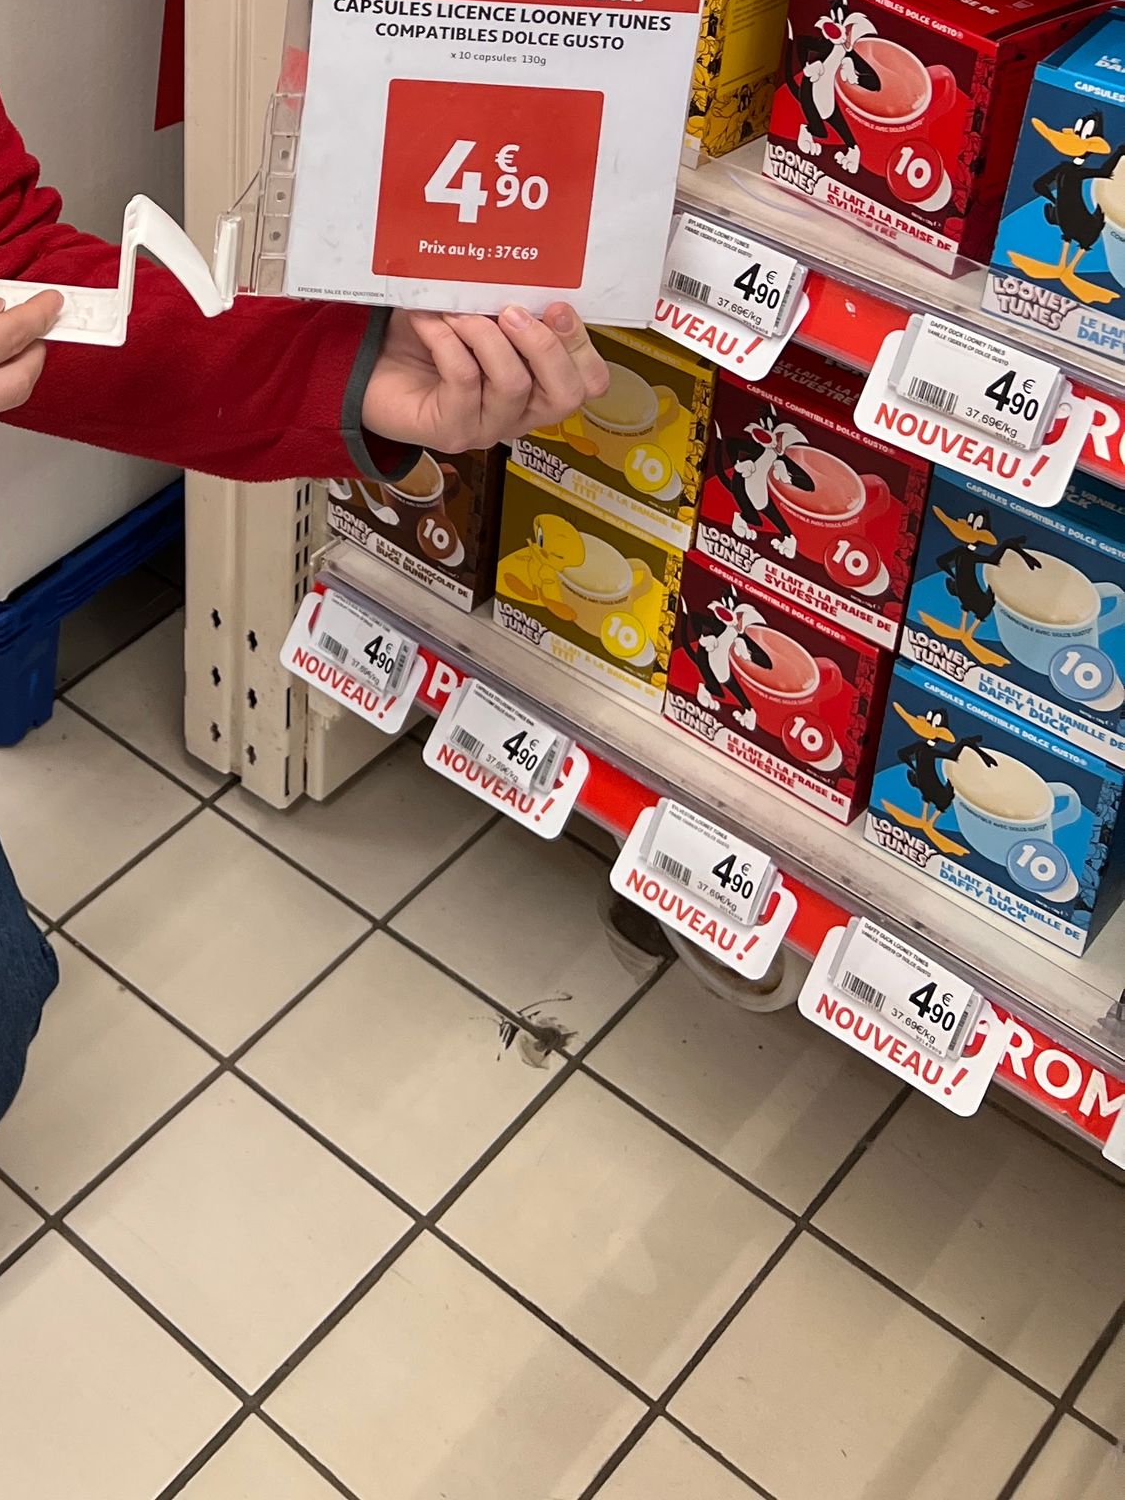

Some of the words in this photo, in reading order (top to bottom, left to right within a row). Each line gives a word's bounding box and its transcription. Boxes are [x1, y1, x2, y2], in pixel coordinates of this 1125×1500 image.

[437, 3, 516, 23] LICENCE
[520, 8, 602, 27] LOONEY
[606, 13, 672, 32] TUNES
[906, 8, 930, 25] DOLCE
[375, 23, 498, 44] COMPATIBLES
[502, 29, 559, 47] DOLCE
[563, 34, 624, 50] GUSTO
[459, 51, 471, 60] 10
[473, 52, 517, 64] capsules
[523, 54, 547, 67] 130g
[769, 144, 826, 182] LOONEY
[771, 160, 816, 195] TUNES
[894, 147, 932, 188] 10
[419, 240, 445, 254] Prix
[448, 246, 466, 255] au
[468, 243, 484, 260] kg
[494, 245, 538, 260] 37€69
[687, 219, 714, 234] SYLVESTRE
[714, 230, 733, 242] LOONEY
[734, 238, 750, 248] TUNES
[717, 297, 762, 325] 37.69€/kg
[930, 320, 947, 332] DAFFY
[948, 327, 963, 339] DUCK
[964, 334, 987, 348] LOONEY
[987, 344, 1005, 355] TUNES
[965, 407, 1017, 438] 37.69€/kg
[517, 438, 571, 472] LOONEY
[520, 452, 562, 483] TUNES
[631, 449, 664, 482] 10
[701, 526, 761, 563] LOONEY
[705, 539, 752, 573] TUNES
[832, 540, 869, 576] 10
[764, 574, 838, 617] SYLVESTRE
[765, 564, 777, 576] LE
[781, 571, 803, 588] LAIT
[818, 590, 831, 603] LA
[835, 598, 874, 624] FRAISE
[876, 619, 892, 632] DE
[908, 629, 976, 671] LOONEY
[912, 644, 966, 682] TUNES
[1060, 651, 1102, 689] 10
[978, 682, 1025, 711] DAFFY
[1029, 708, 1070, 737] DUCK
[980, 673, 994, 684] LE
[997, 681, 1023, 699] LAIT
[1039, 704, 1053, 717] LA
[1057, 712, 1107, 742] VANILLE
[1110, 736, 1125, 751] DE
[891, 1007, 936, 1044] 37.69€/kg
